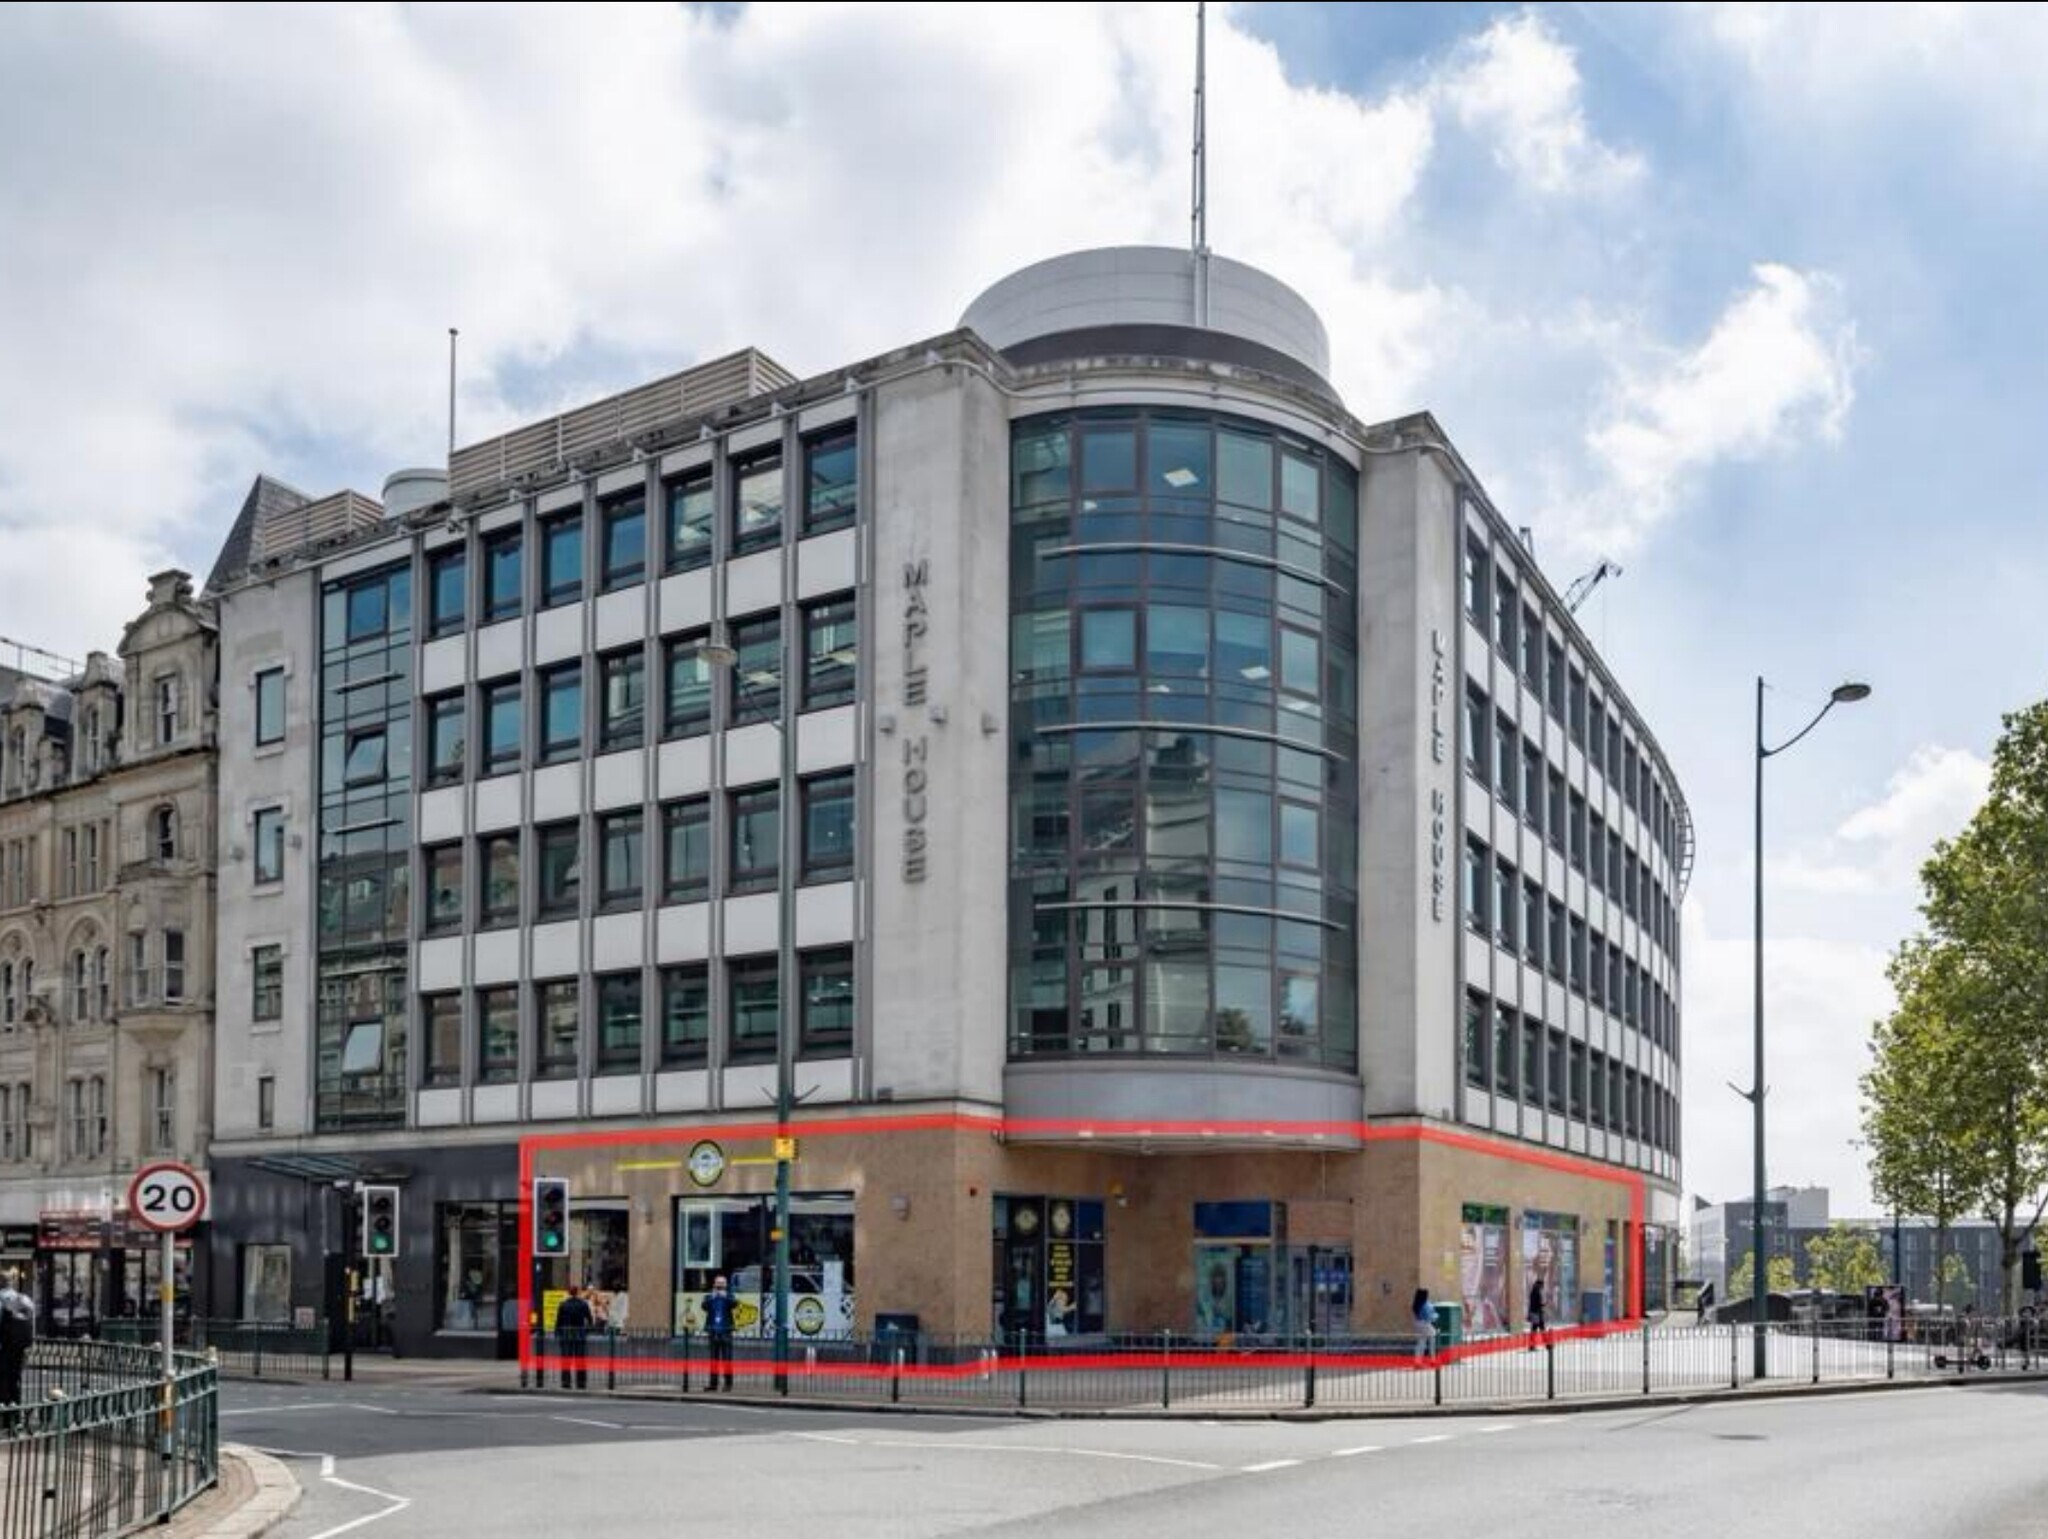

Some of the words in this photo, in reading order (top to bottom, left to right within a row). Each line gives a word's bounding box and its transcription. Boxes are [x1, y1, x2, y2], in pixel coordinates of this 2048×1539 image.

[903, 559, 929, 707] MAPLE
[903, 735, 928, 885] HOUSE
[143, 1185, 196, 1212] 20
